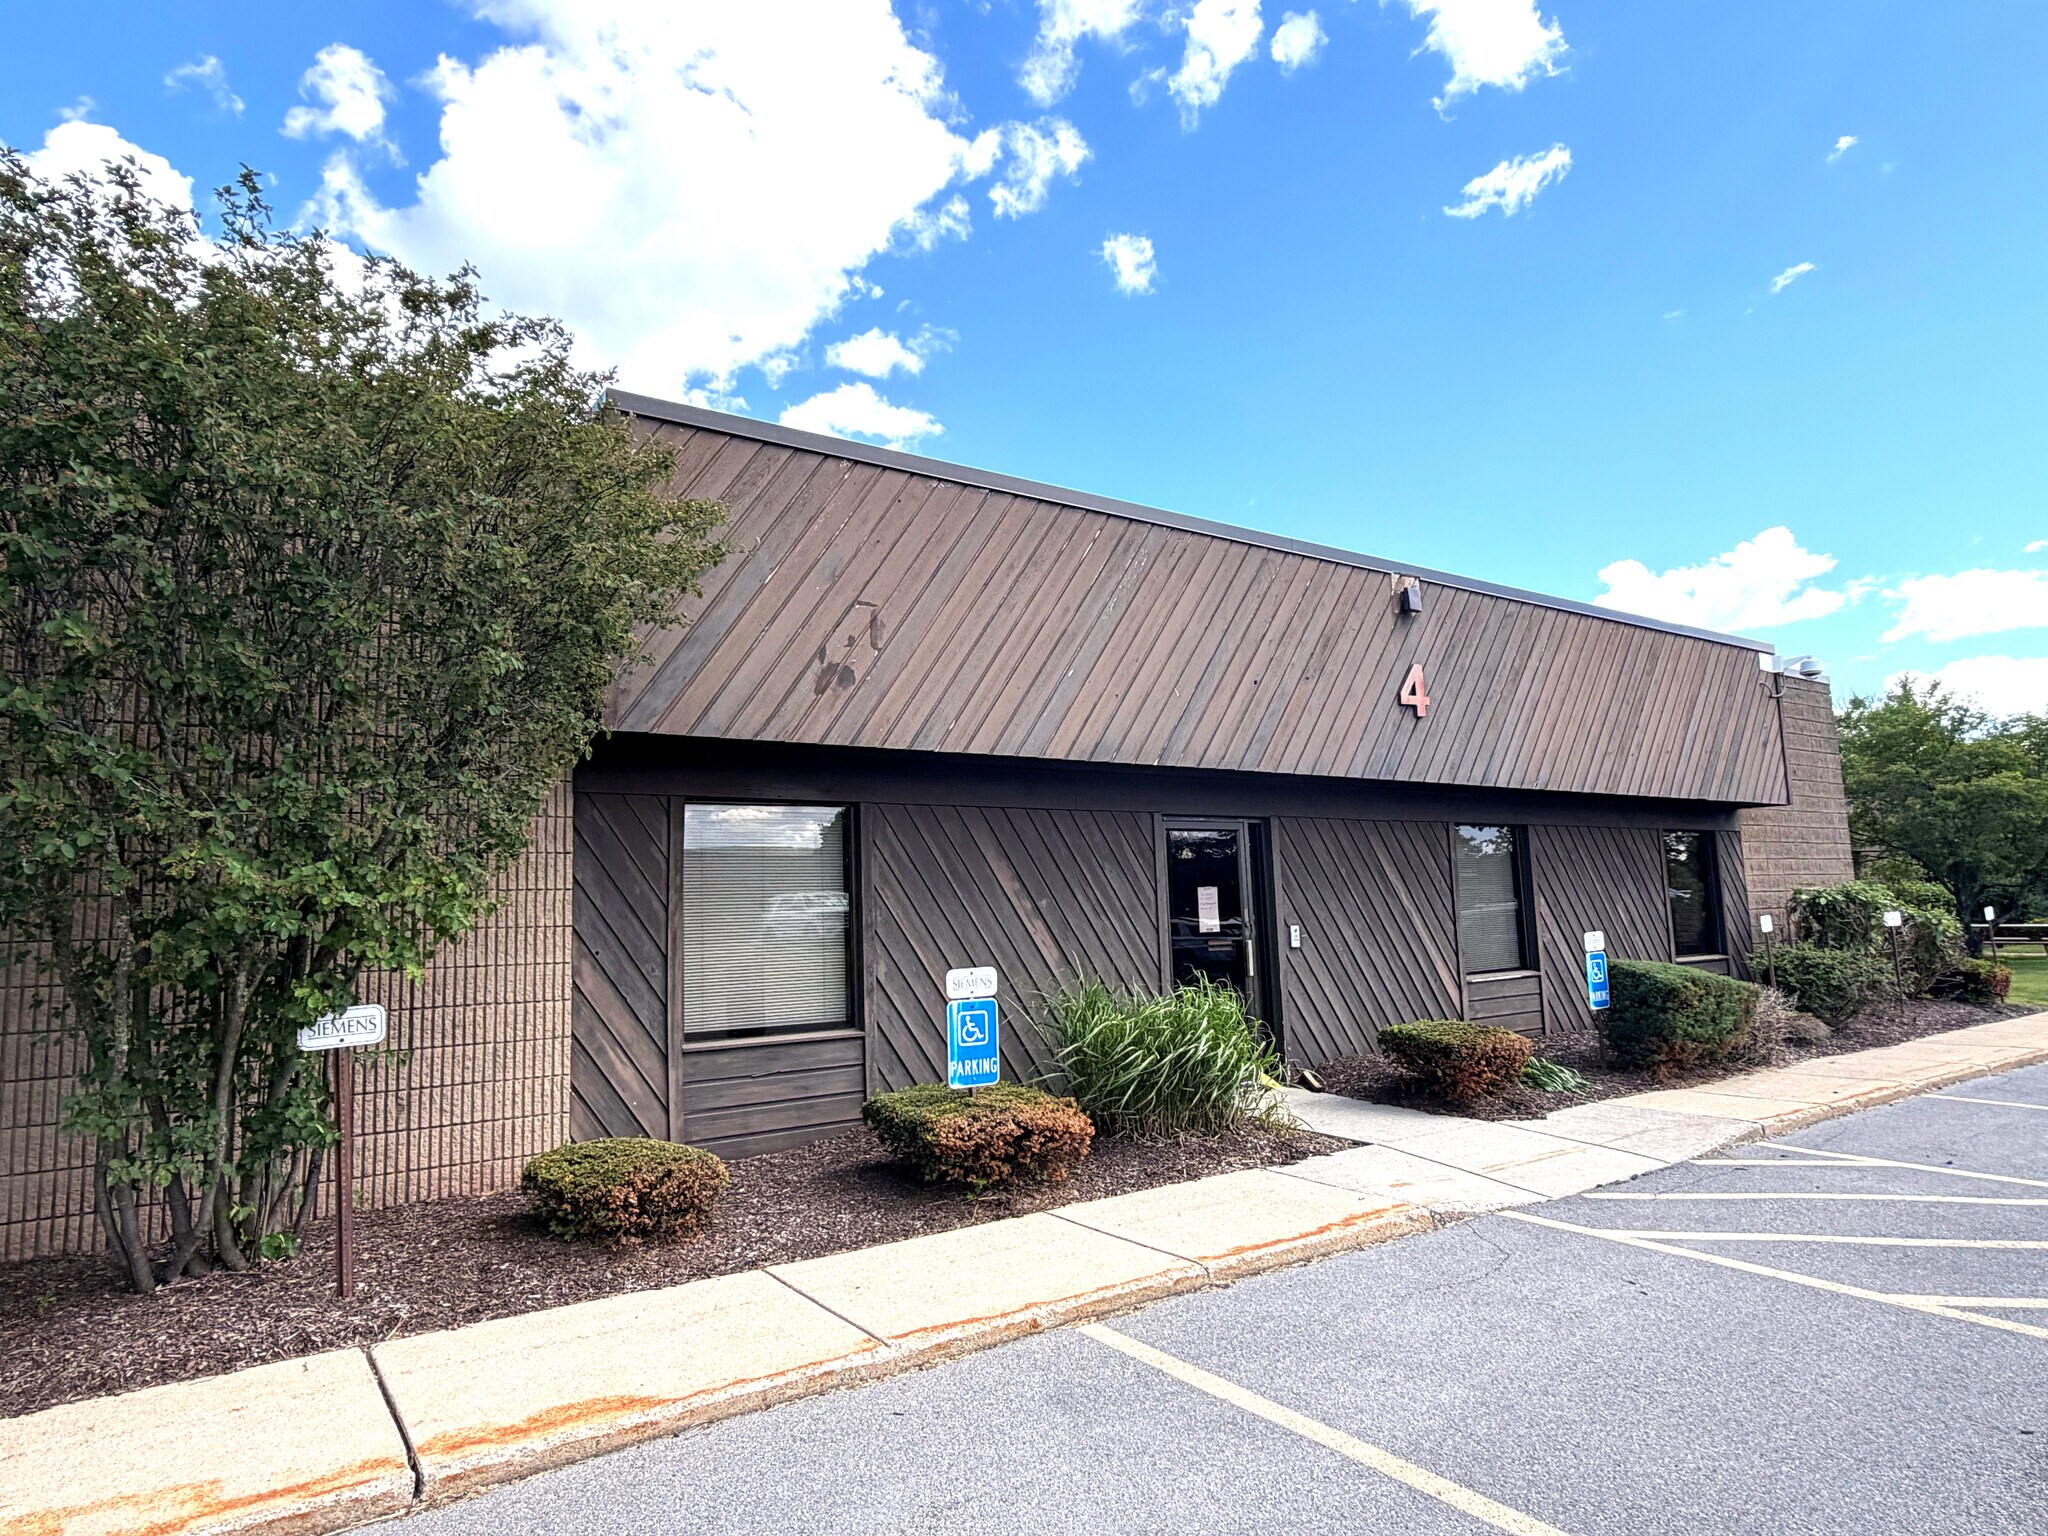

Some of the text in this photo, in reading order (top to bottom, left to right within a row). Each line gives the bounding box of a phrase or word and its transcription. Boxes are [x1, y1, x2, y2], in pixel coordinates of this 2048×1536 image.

[1399, 663, 1430, 718] 4
[952, 976, 993, 989] SIEMENS
[307, 1017, 377, 1038] SIEMENS
[950, 1057, 998, 1077] PARKING
